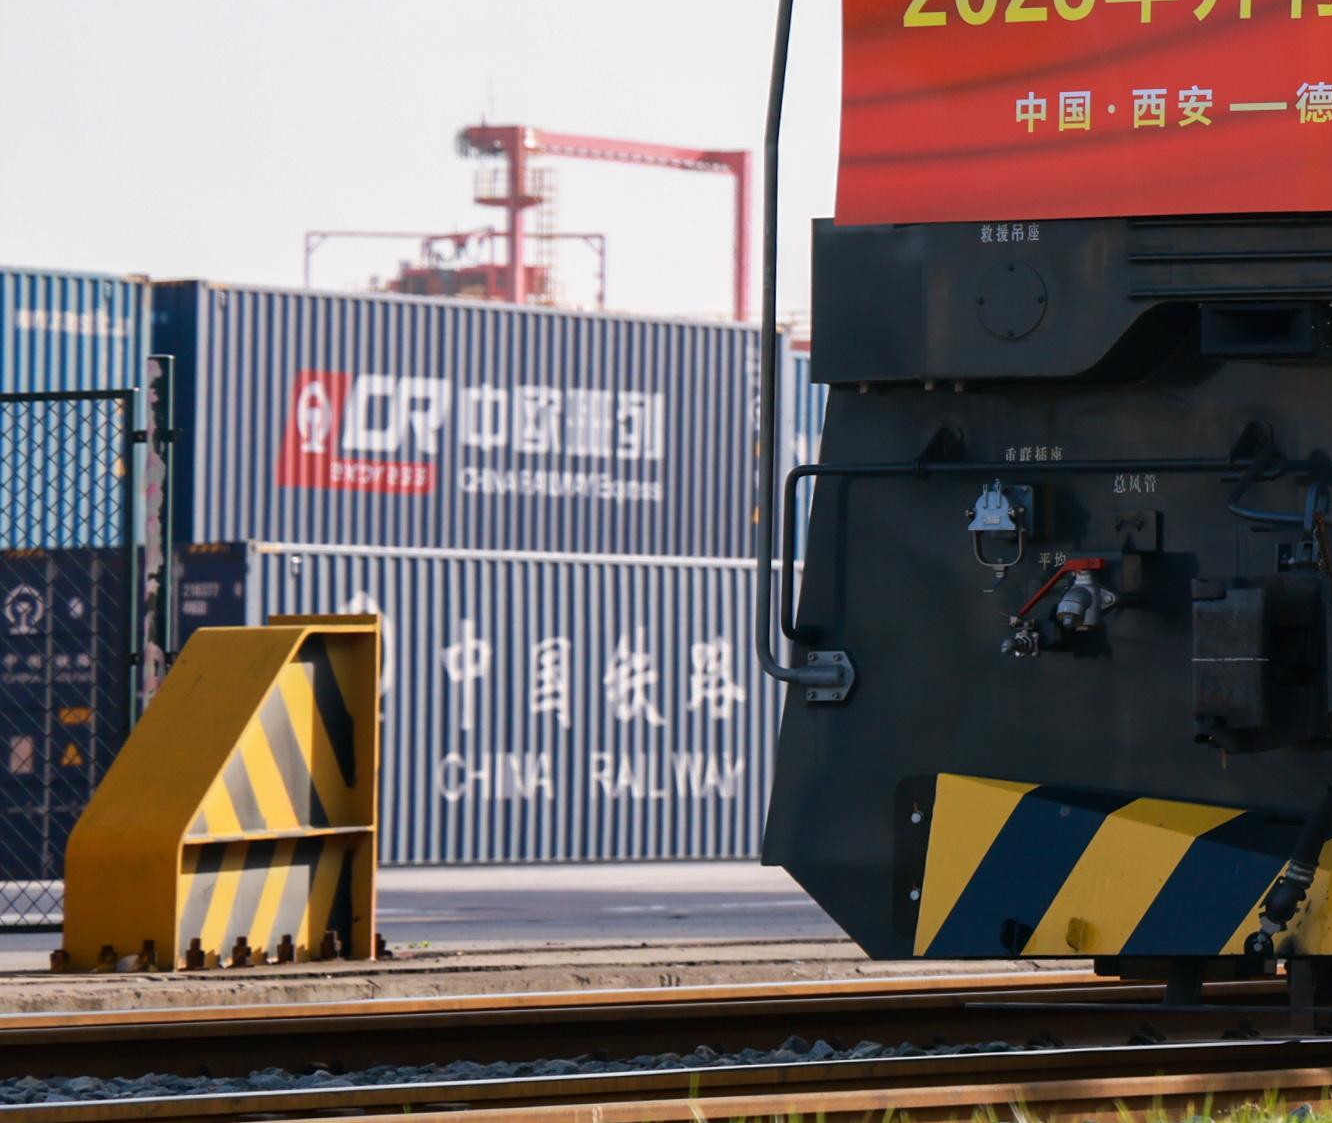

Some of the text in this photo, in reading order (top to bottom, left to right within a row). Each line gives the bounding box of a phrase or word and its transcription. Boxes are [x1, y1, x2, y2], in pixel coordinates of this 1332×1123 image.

[980, 223, 1040, 243] 救援吊座
[342, 373, 451, 455] CR
[461, 382, 665, 460] 中欧班列
[1112, 474, 1158, 494] 总风管
[441, 618, 746, 729] 中国铁路
[439, 751, 745, 801] CHINA RAILWAY
